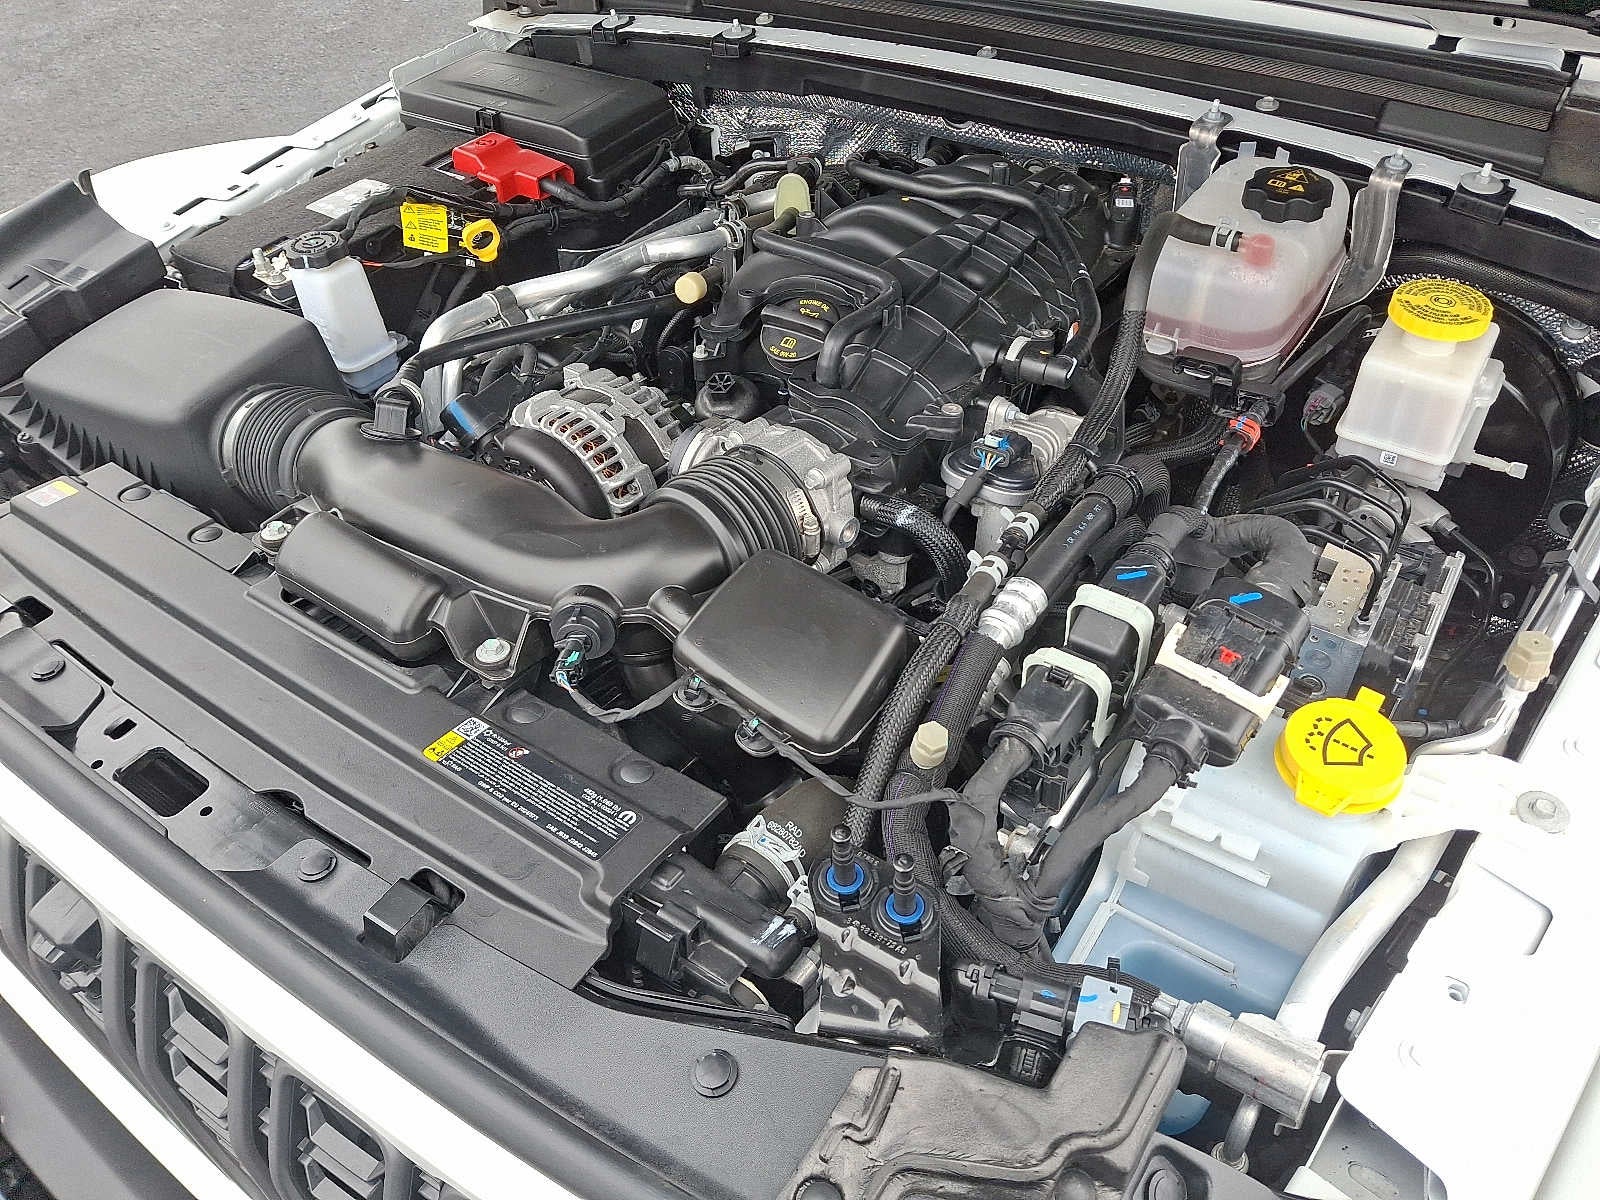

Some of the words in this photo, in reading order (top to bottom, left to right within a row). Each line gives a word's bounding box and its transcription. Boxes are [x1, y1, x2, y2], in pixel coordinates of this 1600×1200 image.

[799, 299, 823, 307] ENGINE
[769, 346, 780, 356] SAE
[785, 820, 803, 838] RAD
